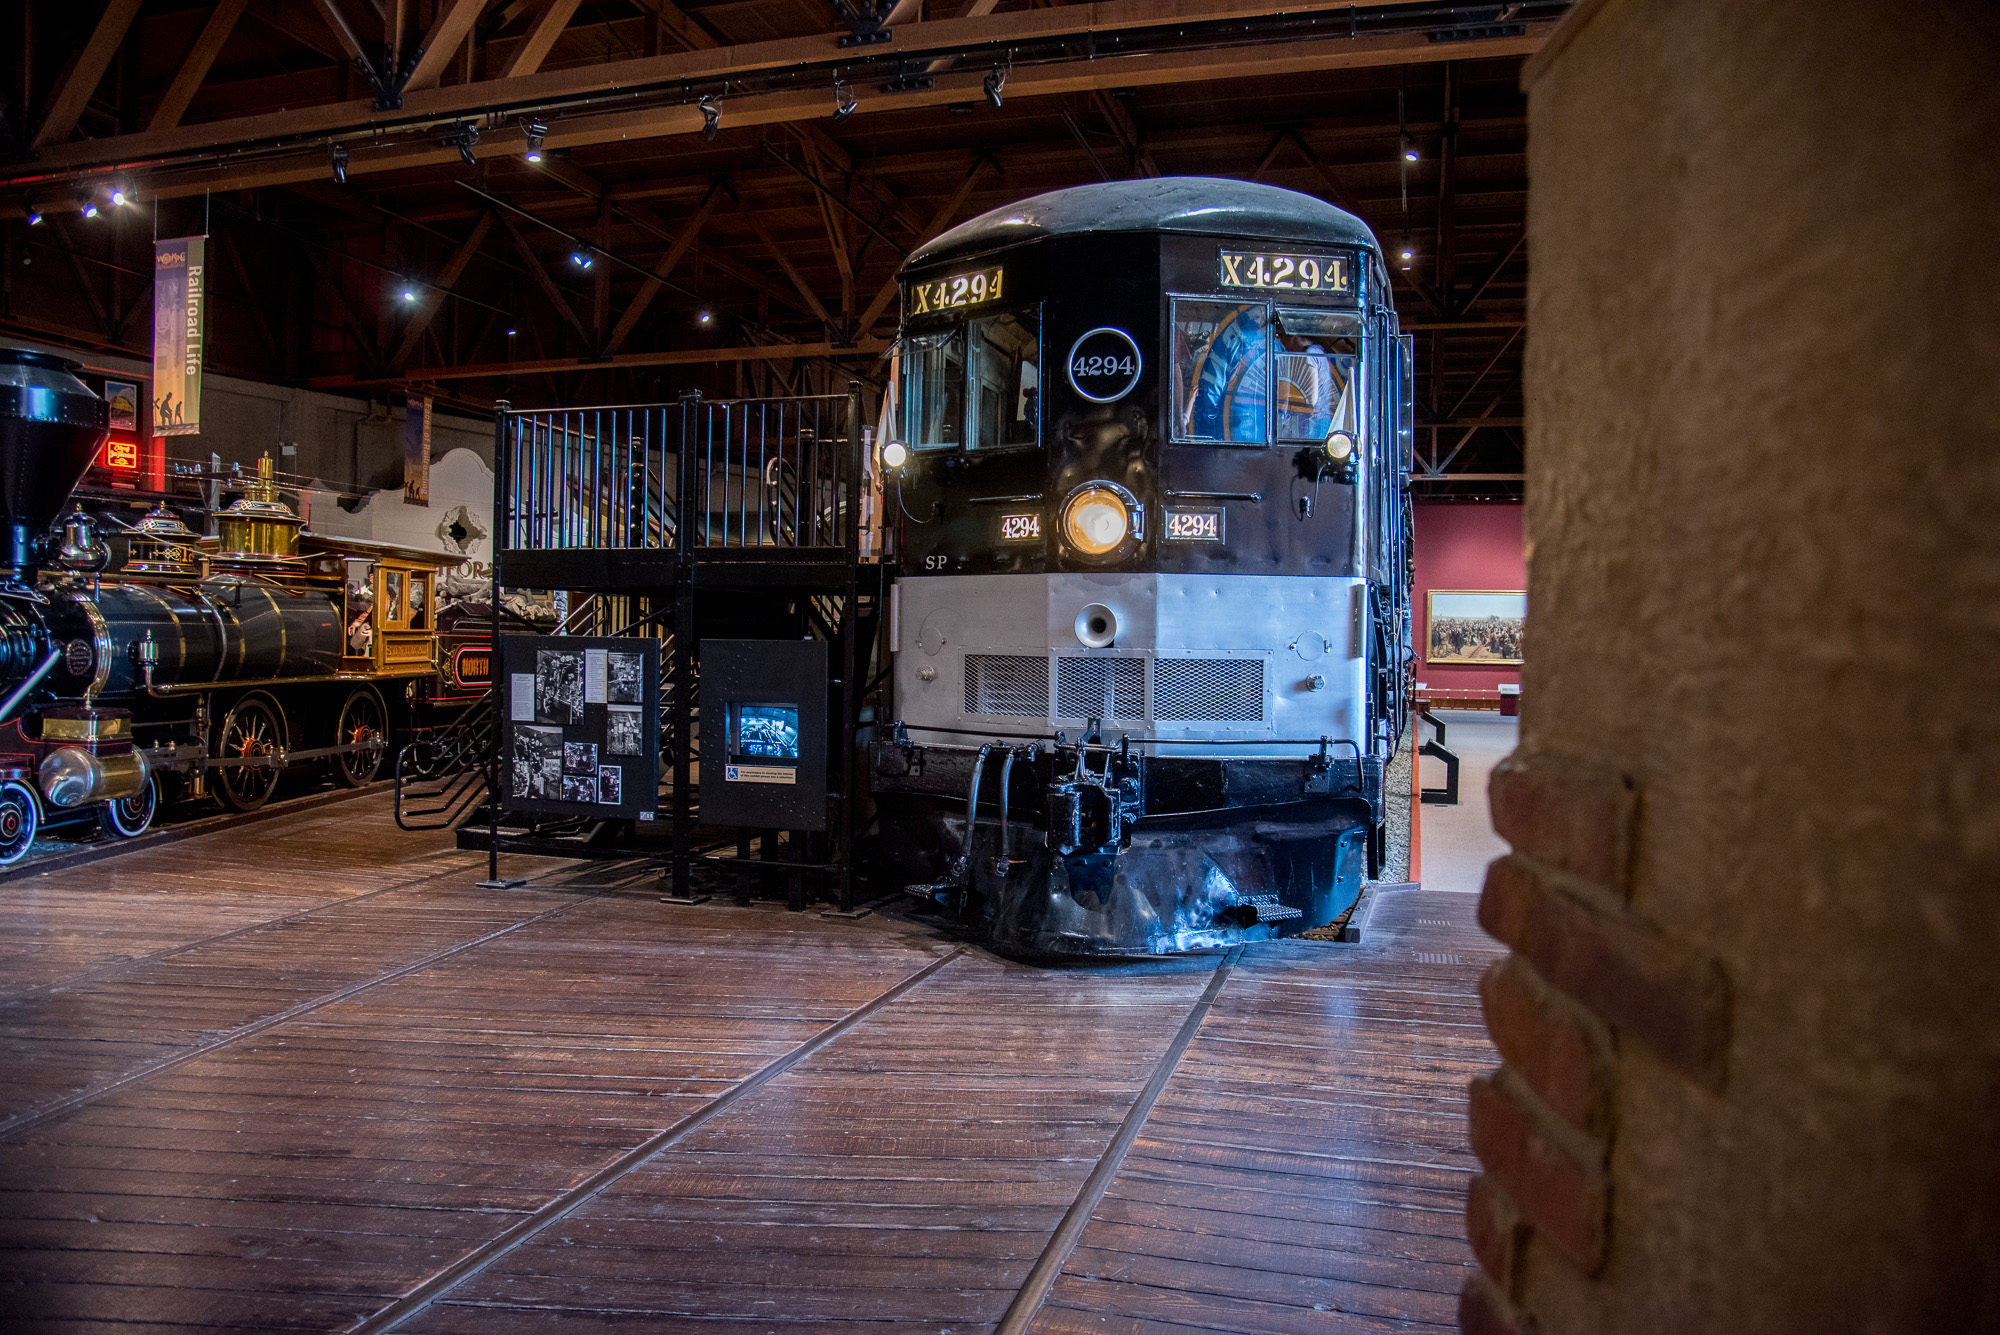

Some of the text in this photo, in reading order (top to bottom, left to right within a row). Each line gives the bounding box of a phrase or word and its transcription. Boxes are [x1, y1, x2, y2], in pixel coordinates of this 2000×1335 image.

[1222, 254, 1347, 291] X4294
[914, 268, 1003, 315] X4294
[185, 265, 203, 376] Railroad Life
[1073, 355, 1135, 376] 4294
[420, 403, 432, 495] Faces of Railroading
[1002, 516, 1040, 539] 4294
[1168, 514, 1217, 537] 4294
[925, 555, 948, 570] SP
[461, 657, 489, 677] NORTH
